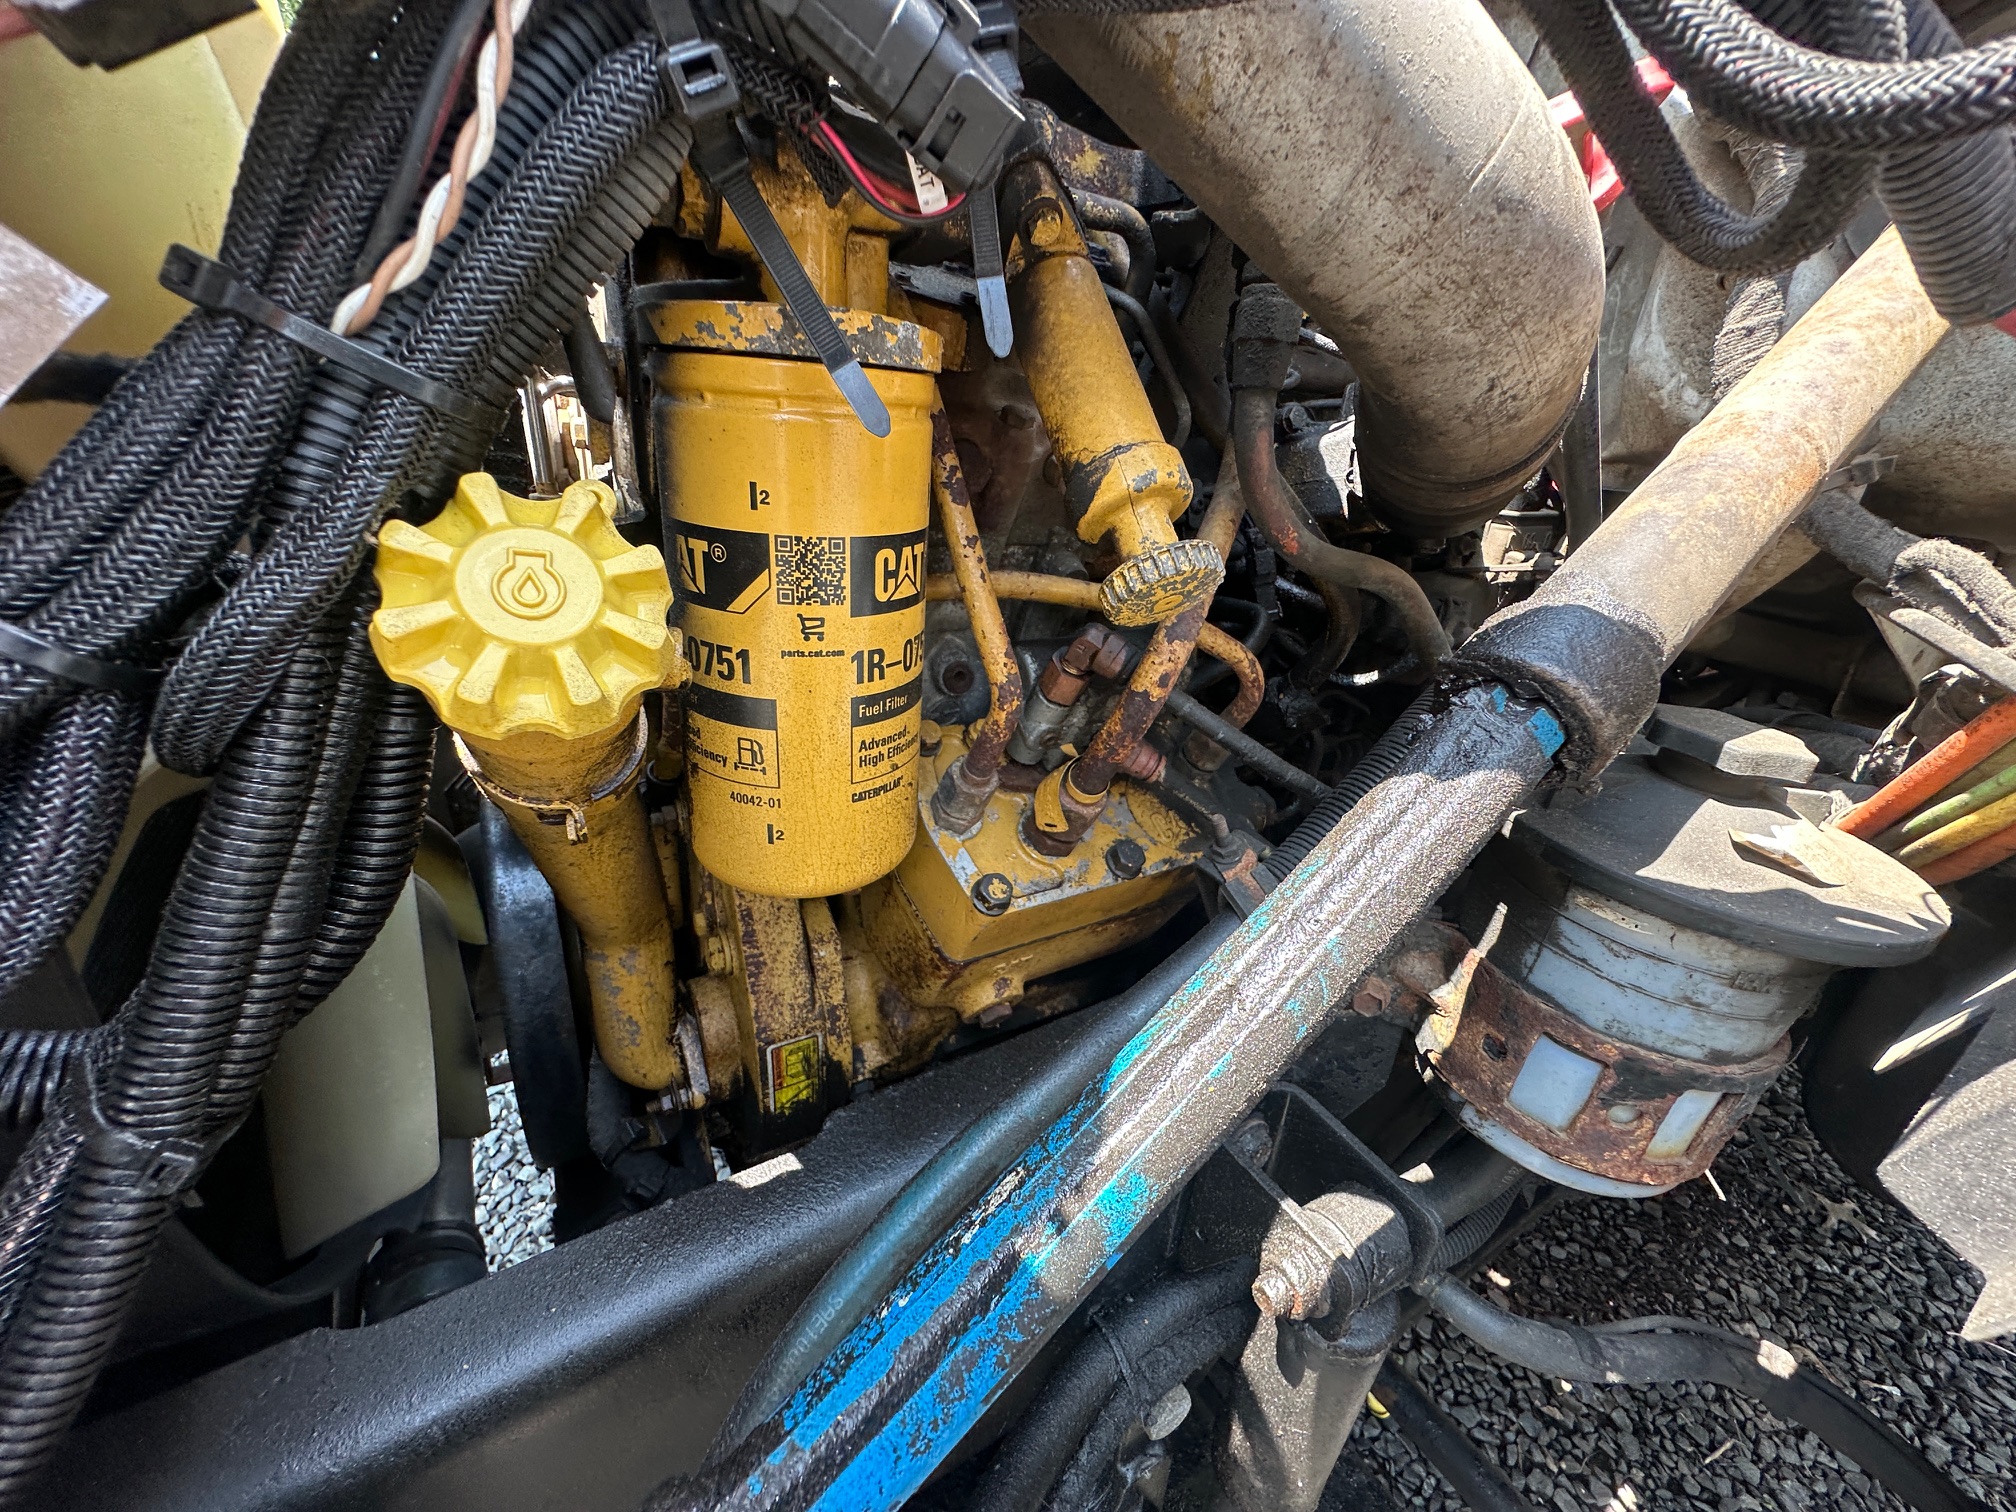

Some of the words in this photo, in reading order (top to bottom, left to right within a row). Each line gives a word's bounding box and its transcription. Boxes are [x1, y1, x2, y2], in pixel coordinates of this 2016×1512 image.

[781, 649, 845, 659] parts.cat.com
[859, 702, 883, 718] Fuel
[886, 695, 908, 711] Filter
[858, 725, 907, 753] Advanced
[859, 751, 884, 768] High
[730, 791, 781, 808] 40042-01
